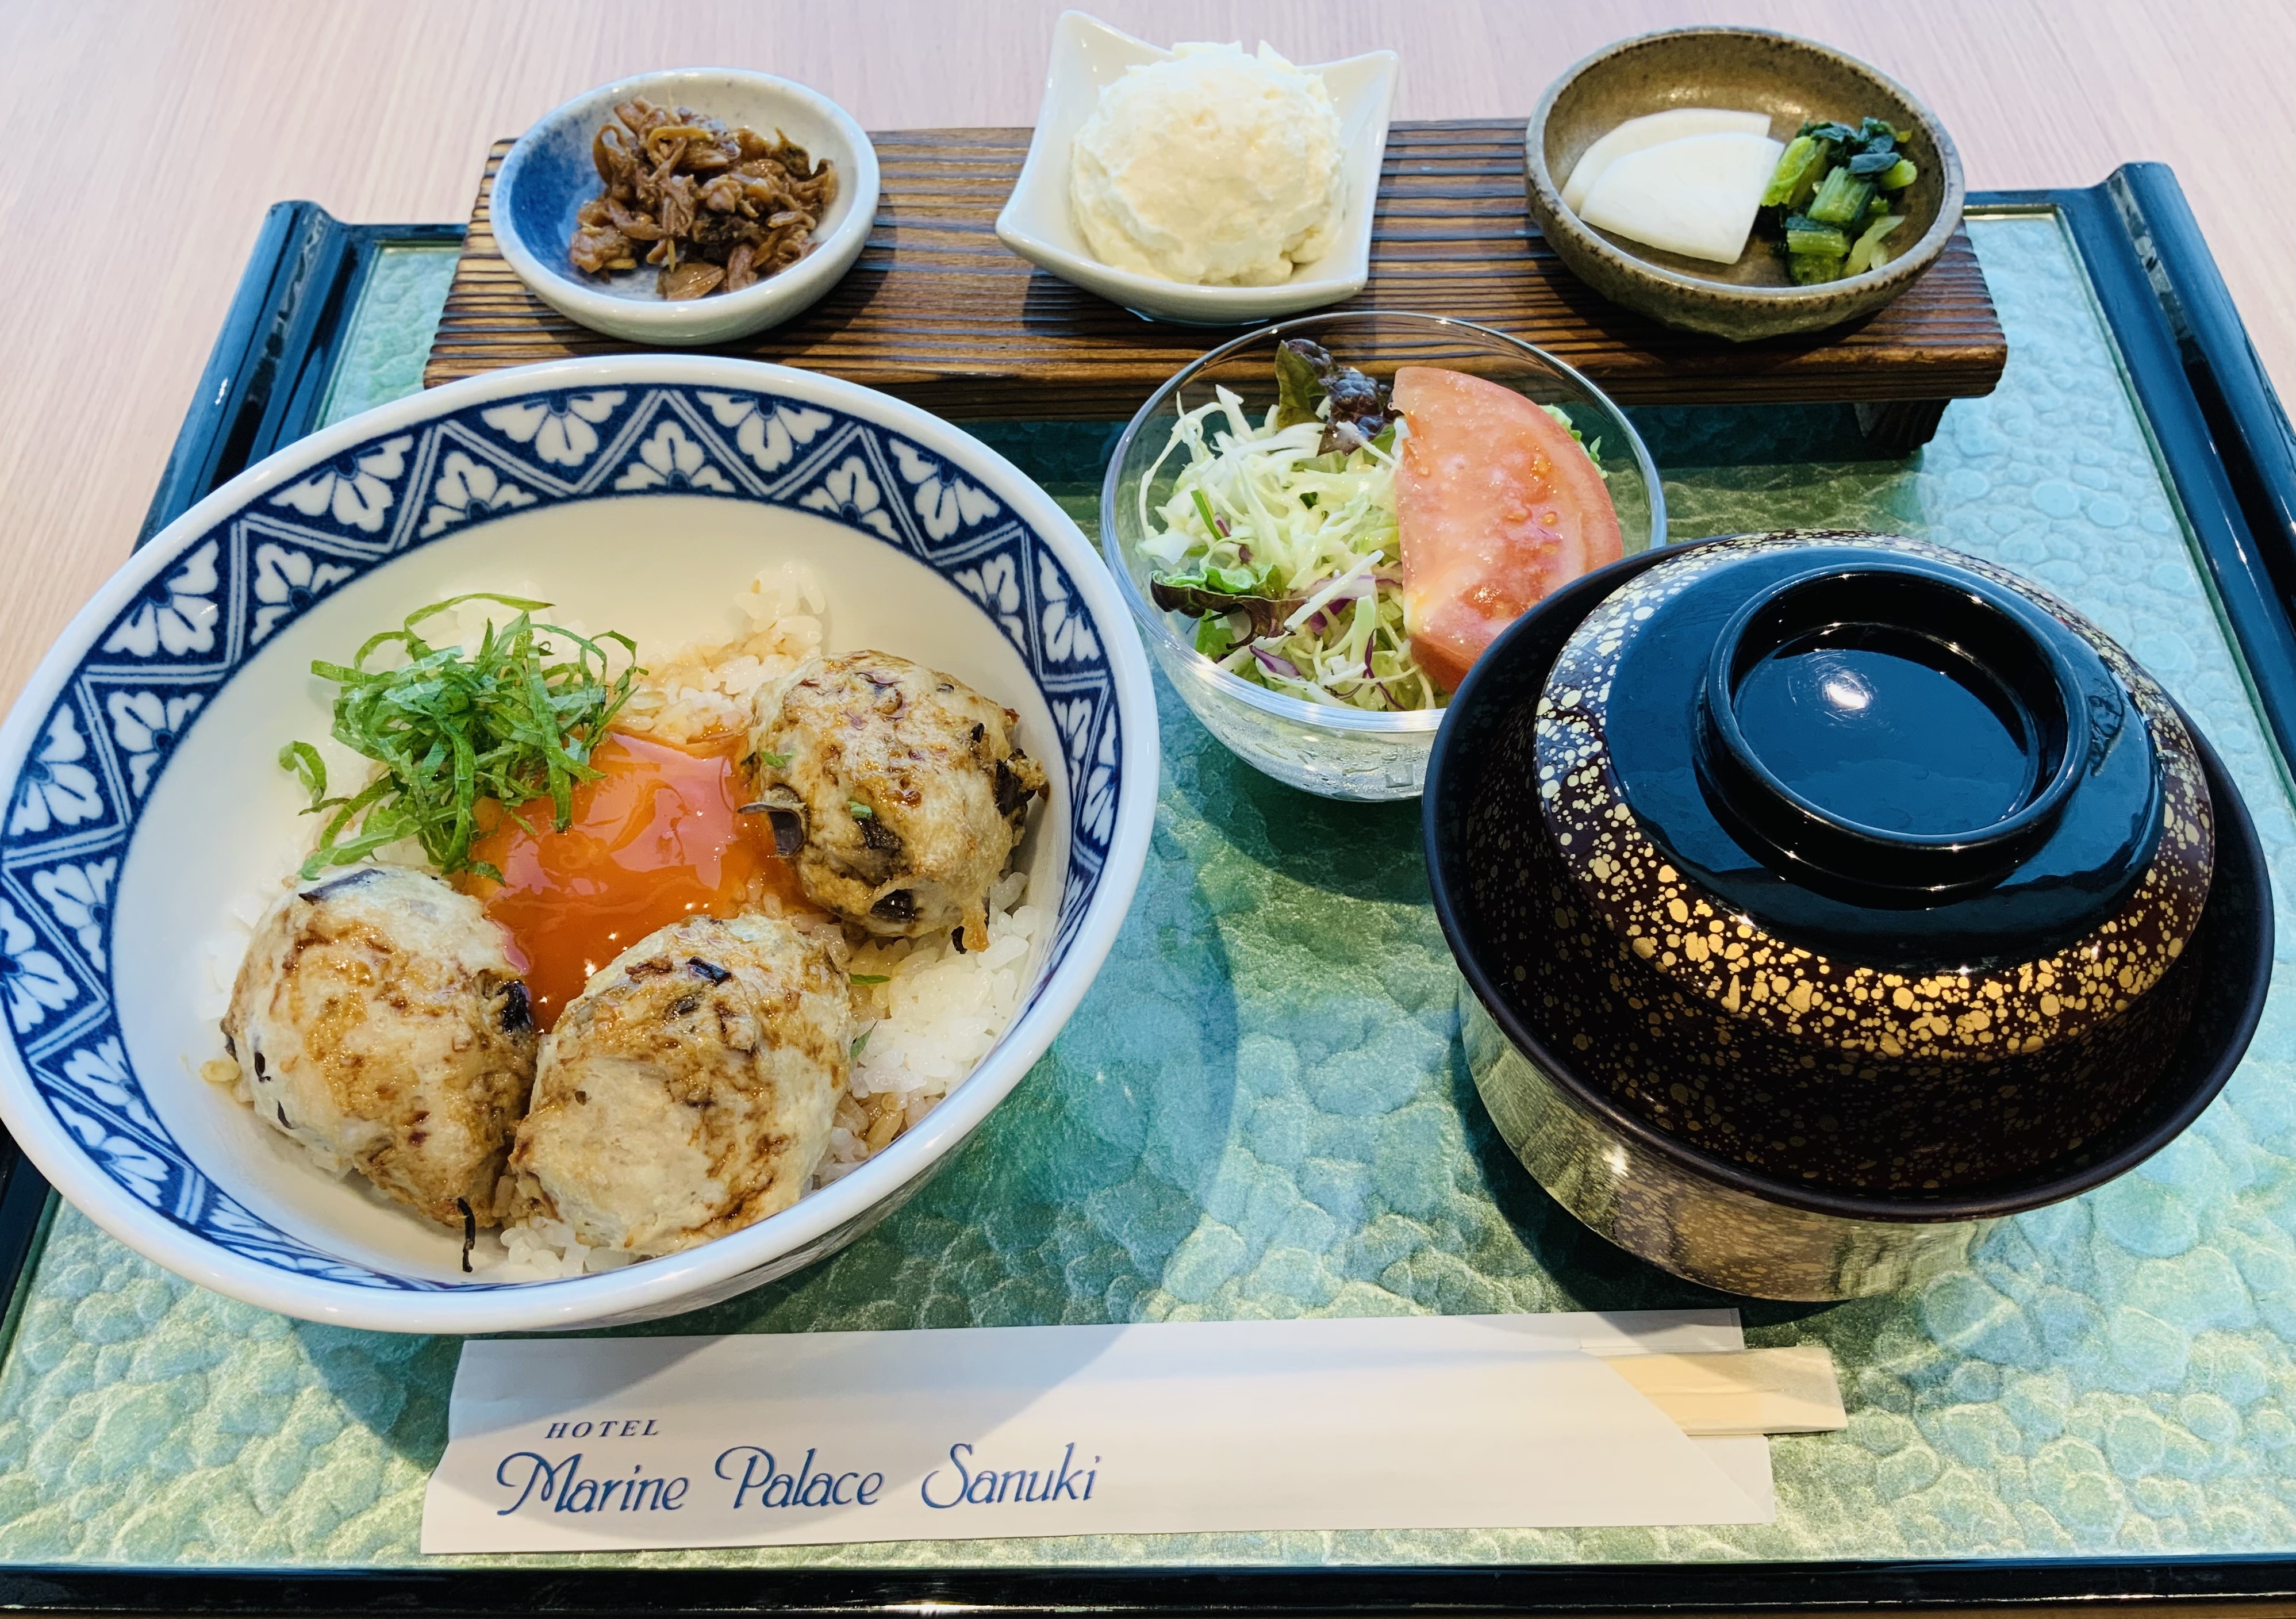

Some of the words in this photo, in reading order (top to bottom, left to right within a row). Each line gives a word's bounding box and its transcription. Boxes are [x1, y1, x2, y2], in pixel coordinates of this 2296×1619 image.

[545, 1419, 660, 1440] HOTEL
[496, 1452, 690, 1516] Marine
[715, 1445, 883, 1509] Palace
[921, 1441, 1100, 1509] Sanuki
